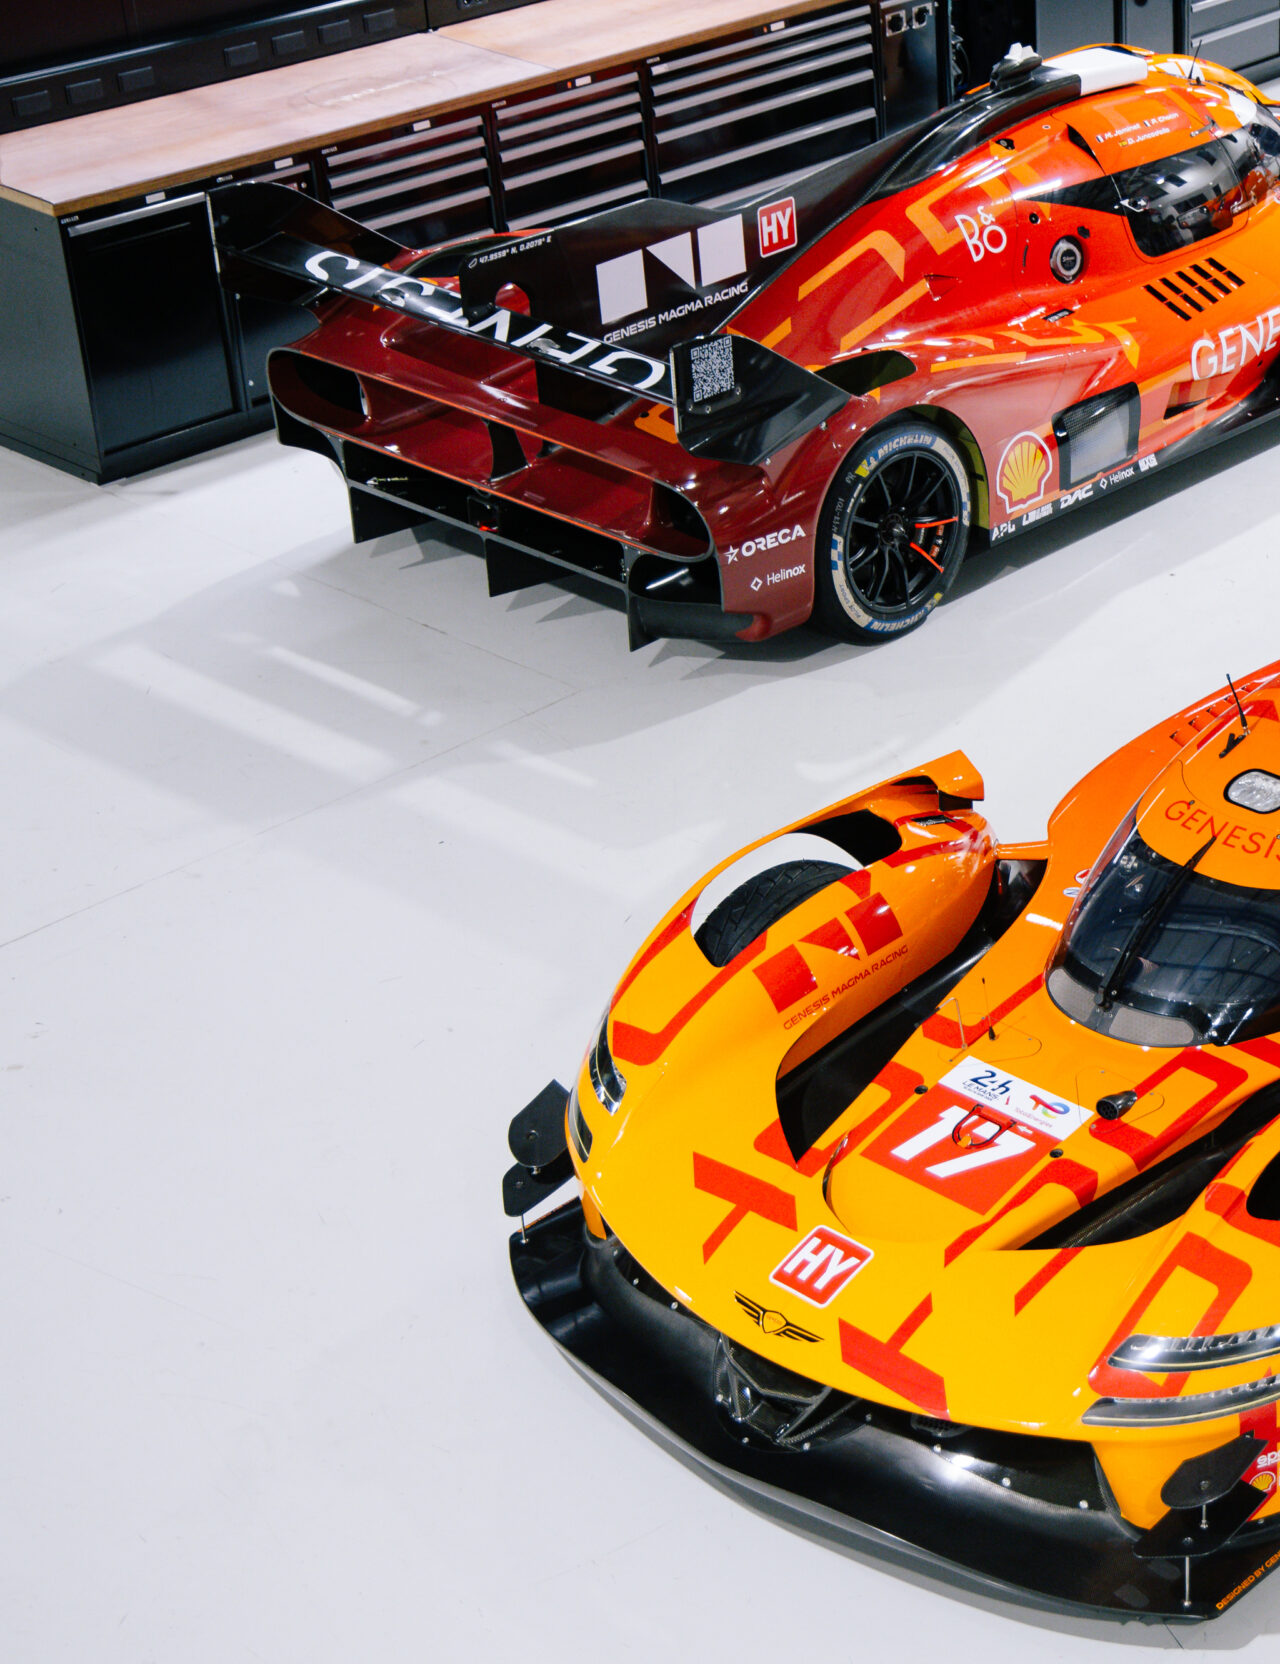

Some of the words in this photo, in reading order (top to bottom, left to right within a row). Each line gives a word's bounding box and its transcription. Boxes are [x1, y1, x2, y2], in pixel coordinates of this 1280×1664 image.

[762, 206, 793, 247] HY
[603, 317, 657, 343] GENESIS
[658, 299, 703, 324] MAGMA
[704, 281, 749, 307] RACING
[877, 434, 933, 459] MICHELIN
[1060, 484, 1094, 509] DAC
[1109, 467, 1135, 485] Helinox
[741, 524, 806, 557] ORECA
[766, 564, 806, 586] Helinox
[783, 994, 830, 1030] GENESIS
[831, 968, 871, 998] MAGMA
[871, 945, 909, 973] RACING
[890, 1105, 1036, 1178] 17
[783, 1236, 861, 1290] HY
[1215, 1574, 1256, 1610] DESIGNED
[1254, 1564, 1265, 1578] BY
